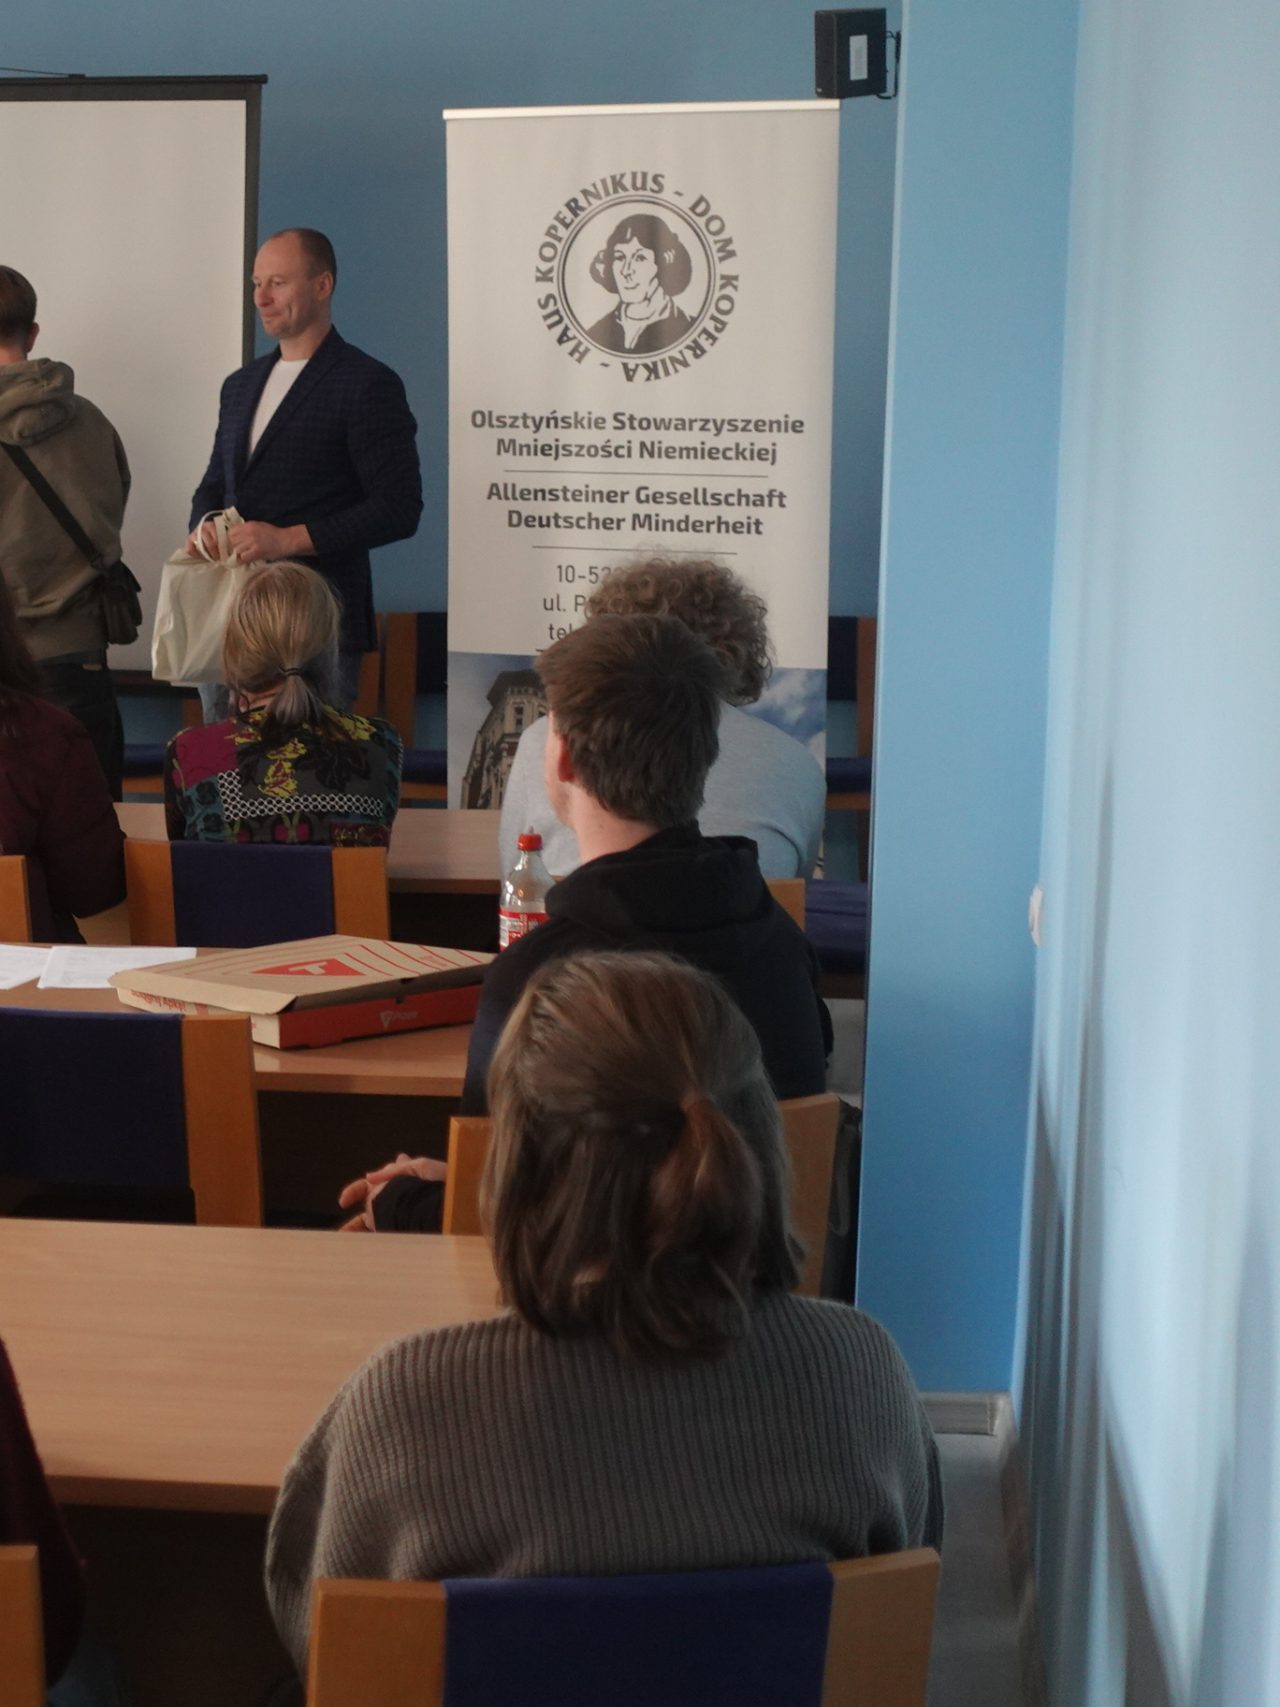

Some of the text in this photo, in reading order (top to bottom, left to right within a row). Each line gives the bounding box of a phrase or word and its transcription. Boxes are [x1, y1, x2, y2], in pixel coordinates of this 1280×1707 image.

[535, 170, 665, 284] KOPERNIKUS
[688, 194, 739, 262] DOM
[536, 291, 592, 365] HAUS
[620, 273, 740, 383] KOPERNIKA
[470, 409, 805, 438] Olsztyńskie Stowarzyszenie
[496, 437, 778, 466] Mniejszości Niemieckiej
[486, 482, 787, 509] Allensteiner Gesellschaft
[507, 509, 764, 536] Deutscher Minderheit
[543, 593, 567, 612] ul.
